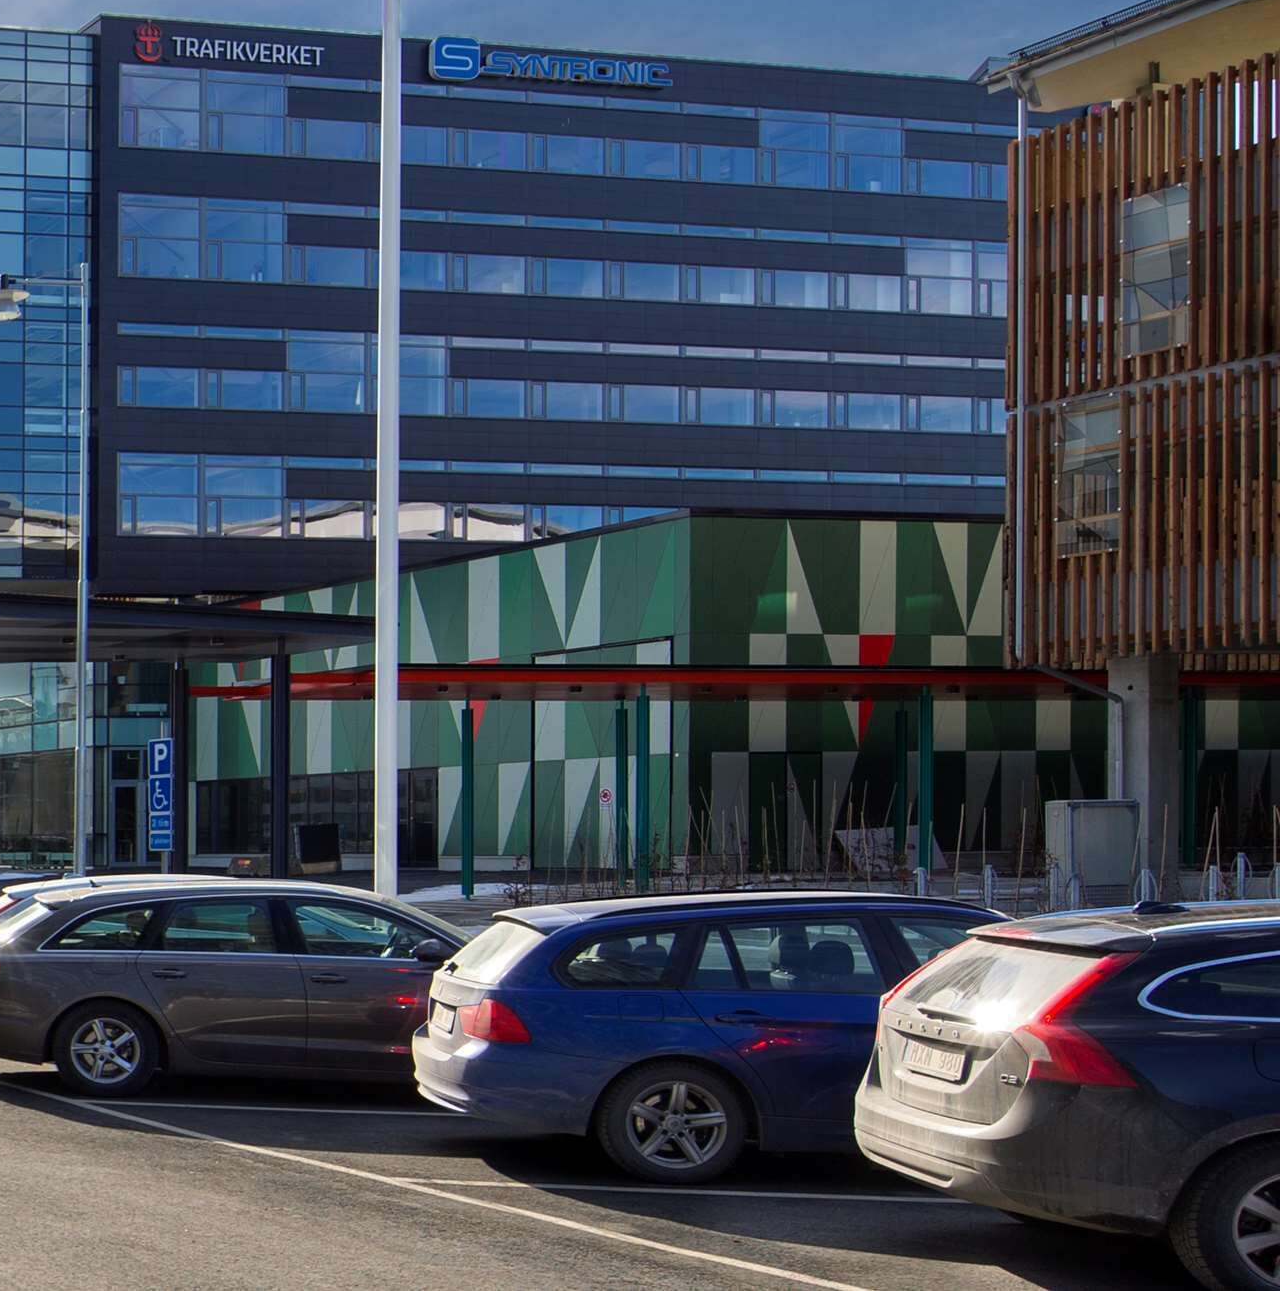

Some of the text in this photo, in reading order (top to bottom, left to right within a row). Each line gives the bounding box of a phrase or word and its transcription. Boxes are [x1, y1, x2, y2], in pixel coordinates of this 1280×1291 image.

[171, 35, 326, 67] TRAFIKVERKET
[481, 50, 673, 87] SYNTRONIC
[154, 743, 167, 772] P
